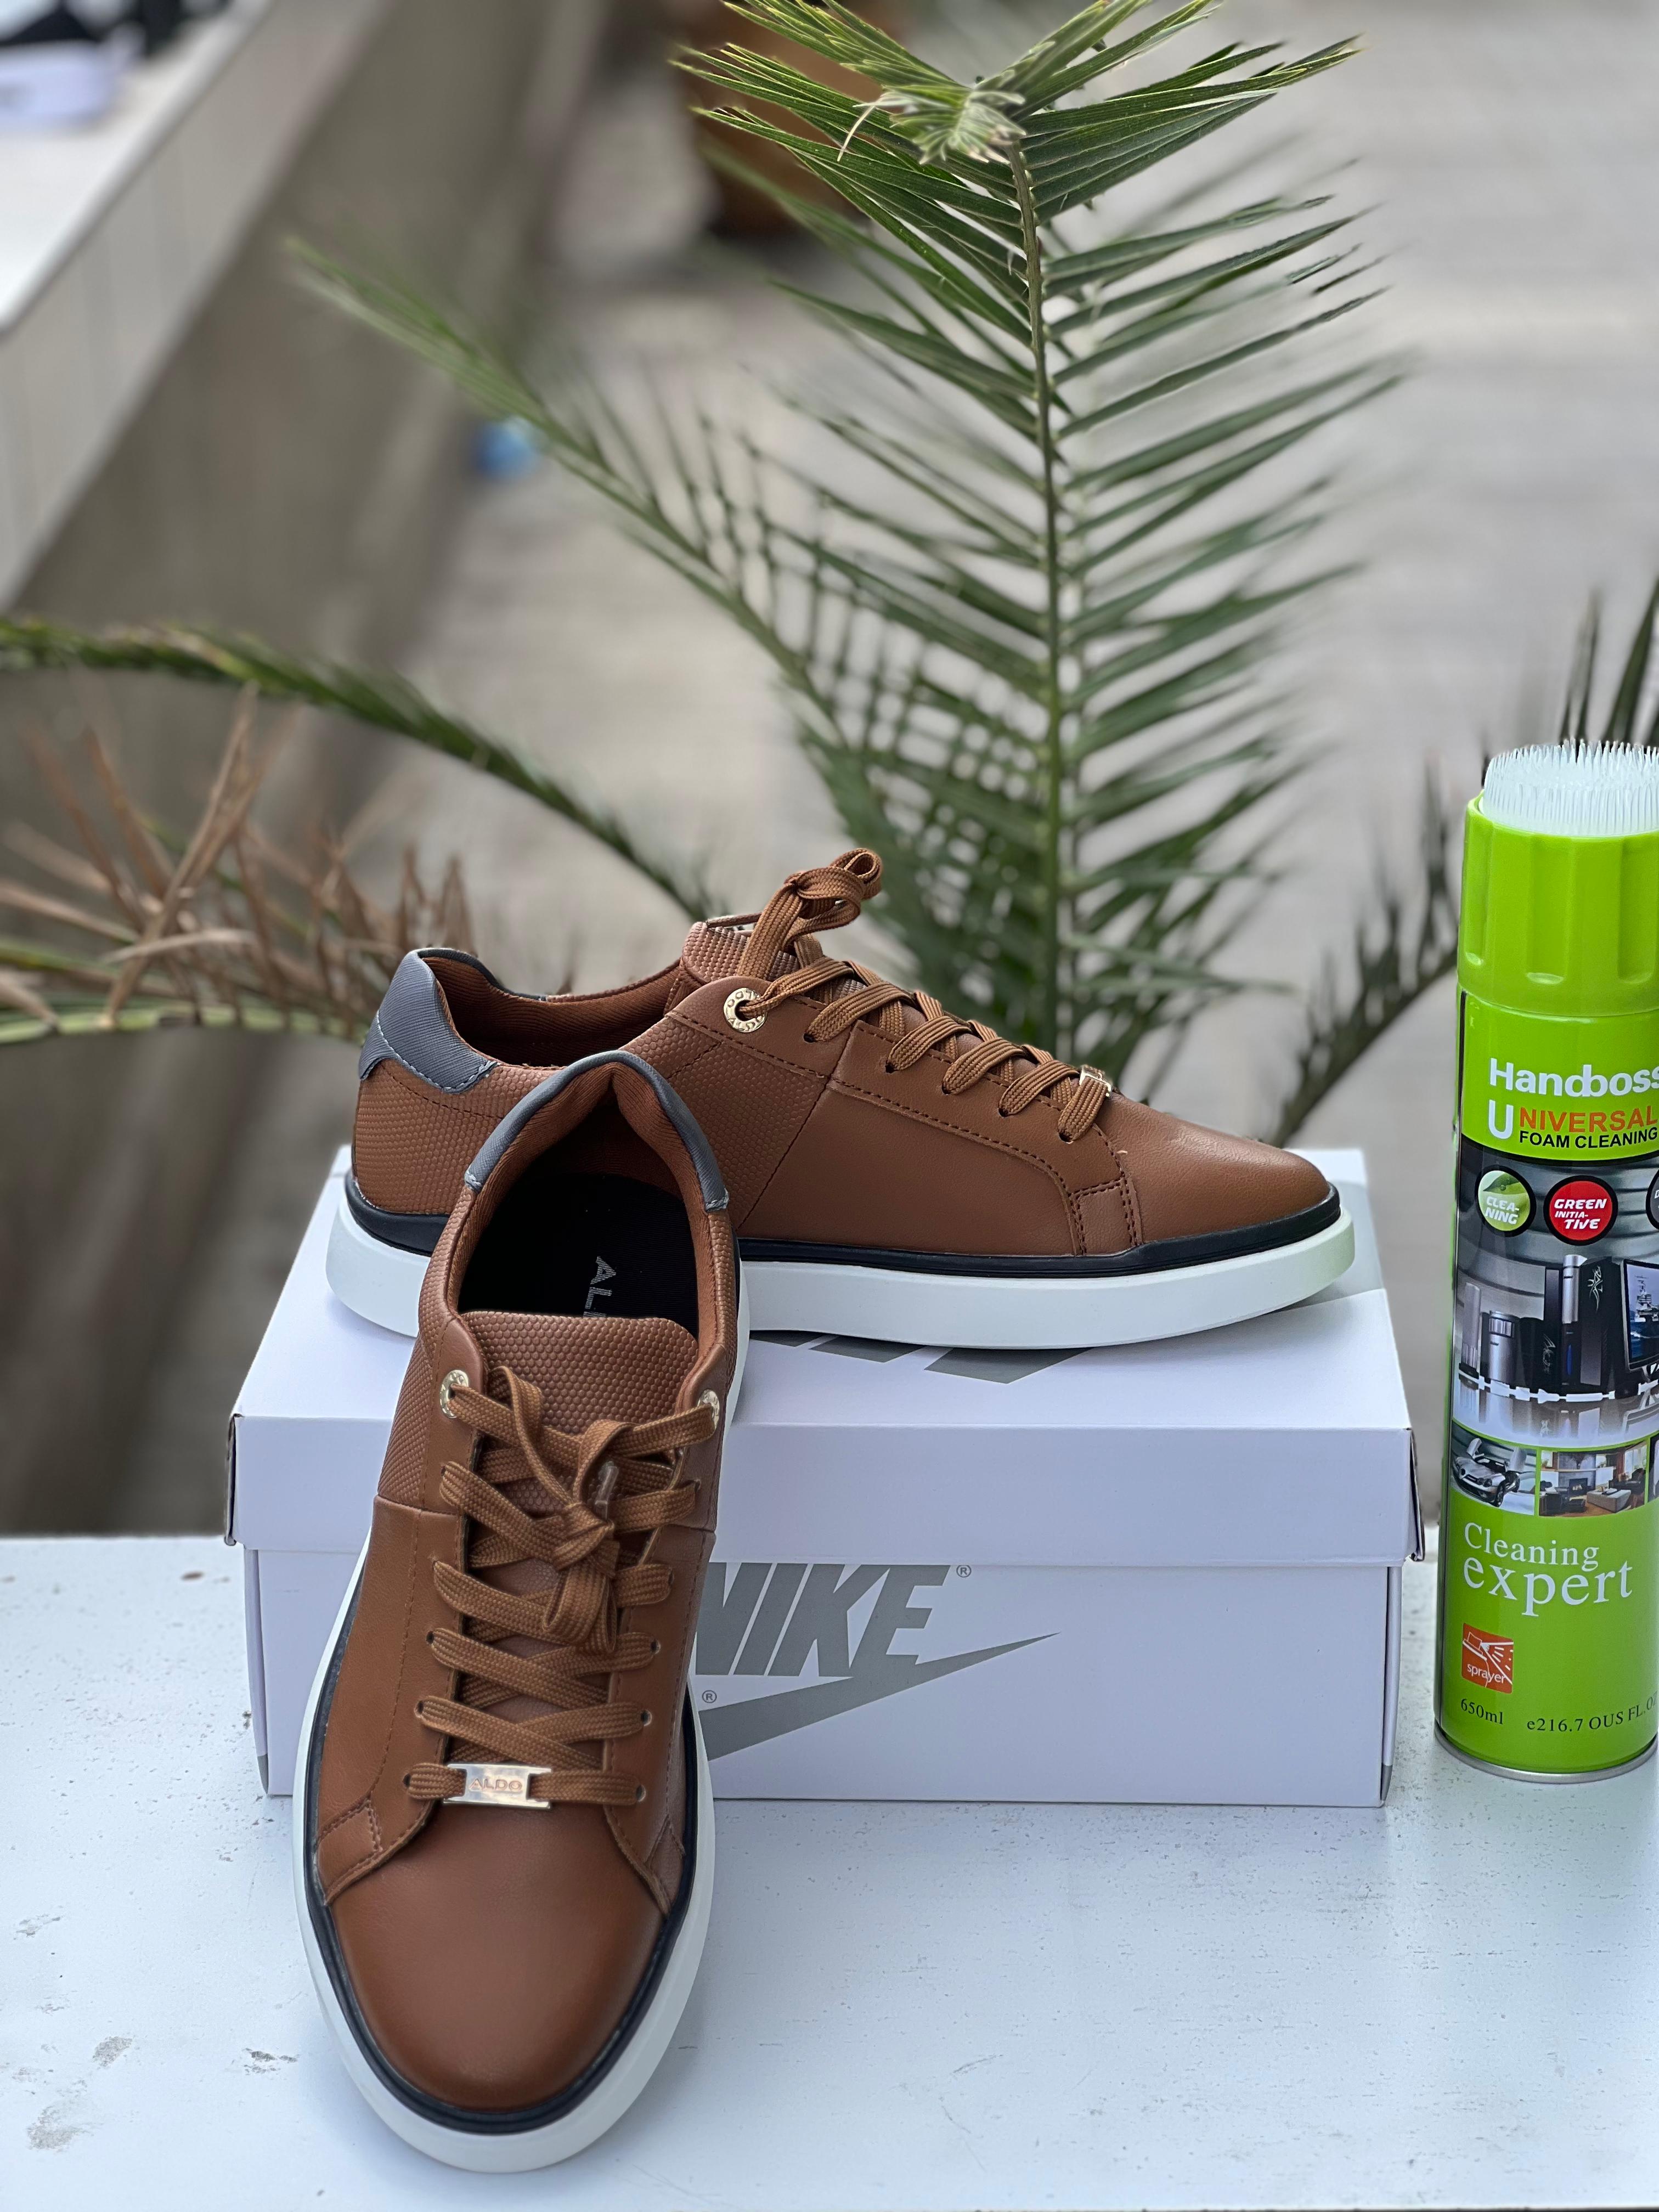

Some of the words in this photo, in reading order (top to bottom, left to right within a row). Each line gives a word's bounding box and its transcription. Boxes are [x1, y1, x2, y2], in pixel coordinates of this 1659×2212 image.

[1488, 1099, 1658, 1139] UNIVERSAL
[1519, 1130, 1570, 1148] FOAM
[1575, 1126, 1658, 1148] CLEANING
[1486, 1207, 1518, 1225] NING
[1554, 1198, 1607, 1210] GREEN
[1564, 1218, 1601, 1229] TIVE
[583, 1256, 617, 1317] AL
[1464, 1522, 1600, 1572] Cleaning
[1464, 1557, 1633, 1617] expert
[695, 1562, 951, 1677] NIKE
[1467, 1663, 1505, 1684] sprayer
[1461, 1699, 1504, 1725] 650ml
[469, 1778, 523, 1792] ALDO
